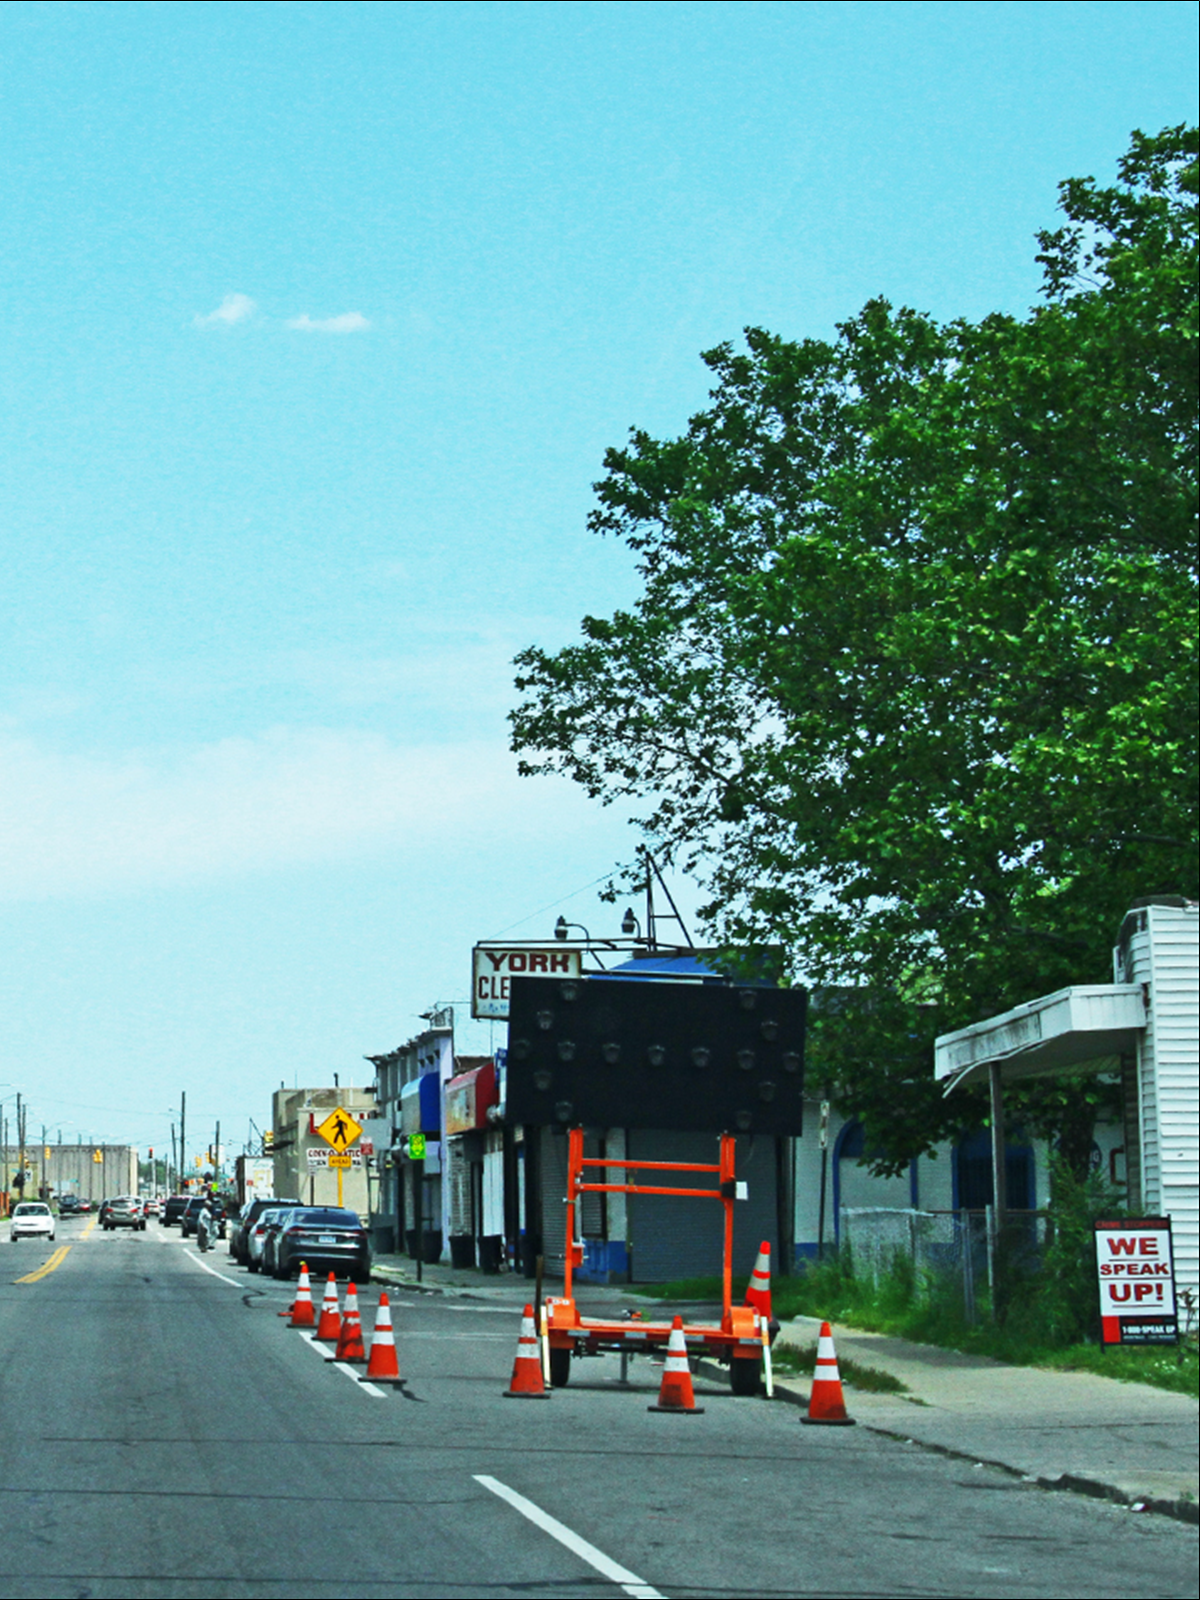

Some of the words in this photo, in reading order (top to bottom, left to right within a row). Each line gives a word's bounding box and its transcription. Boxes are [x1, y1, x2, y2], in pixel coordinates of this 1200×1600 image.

[485, 952, 570, 972] YORK
[478, 976, 510, 999] CLE
[1107, 1237, 1159, 1256] WE
[1100, 1262, 1169, 1276] SPEAK
[1109, 1283, 1164, 1303] UP!
